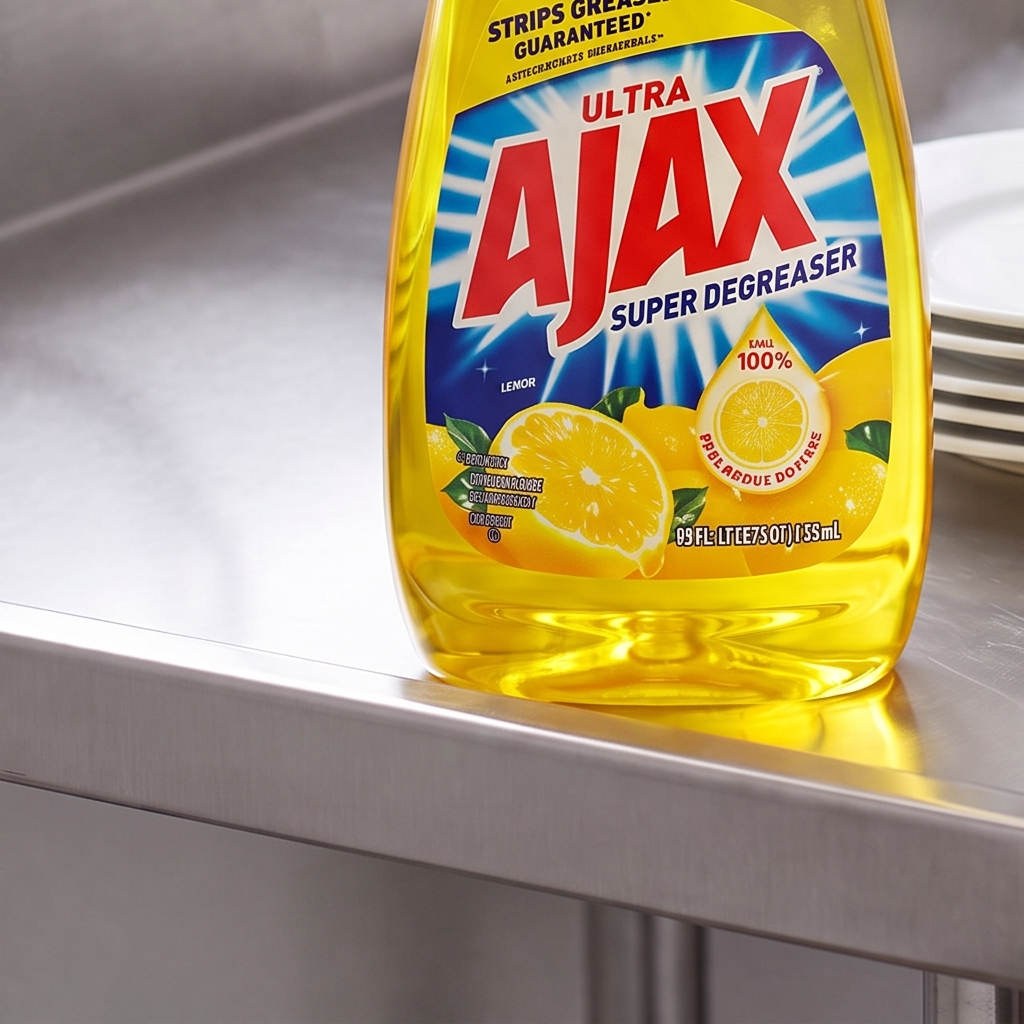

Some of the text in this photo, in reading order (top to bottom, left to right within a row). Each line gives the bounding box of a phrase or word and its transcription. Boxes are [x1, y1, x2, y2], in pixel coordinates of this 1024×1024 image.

[488, 2, 565, 43] STRIPS
[580, 75, 690, 123] ULTRA
[460, 74, 818, 349] AJAX
[610, 242, 858, 332] SUPER DEGREASER
[737, 351, 793, 371] 100%
